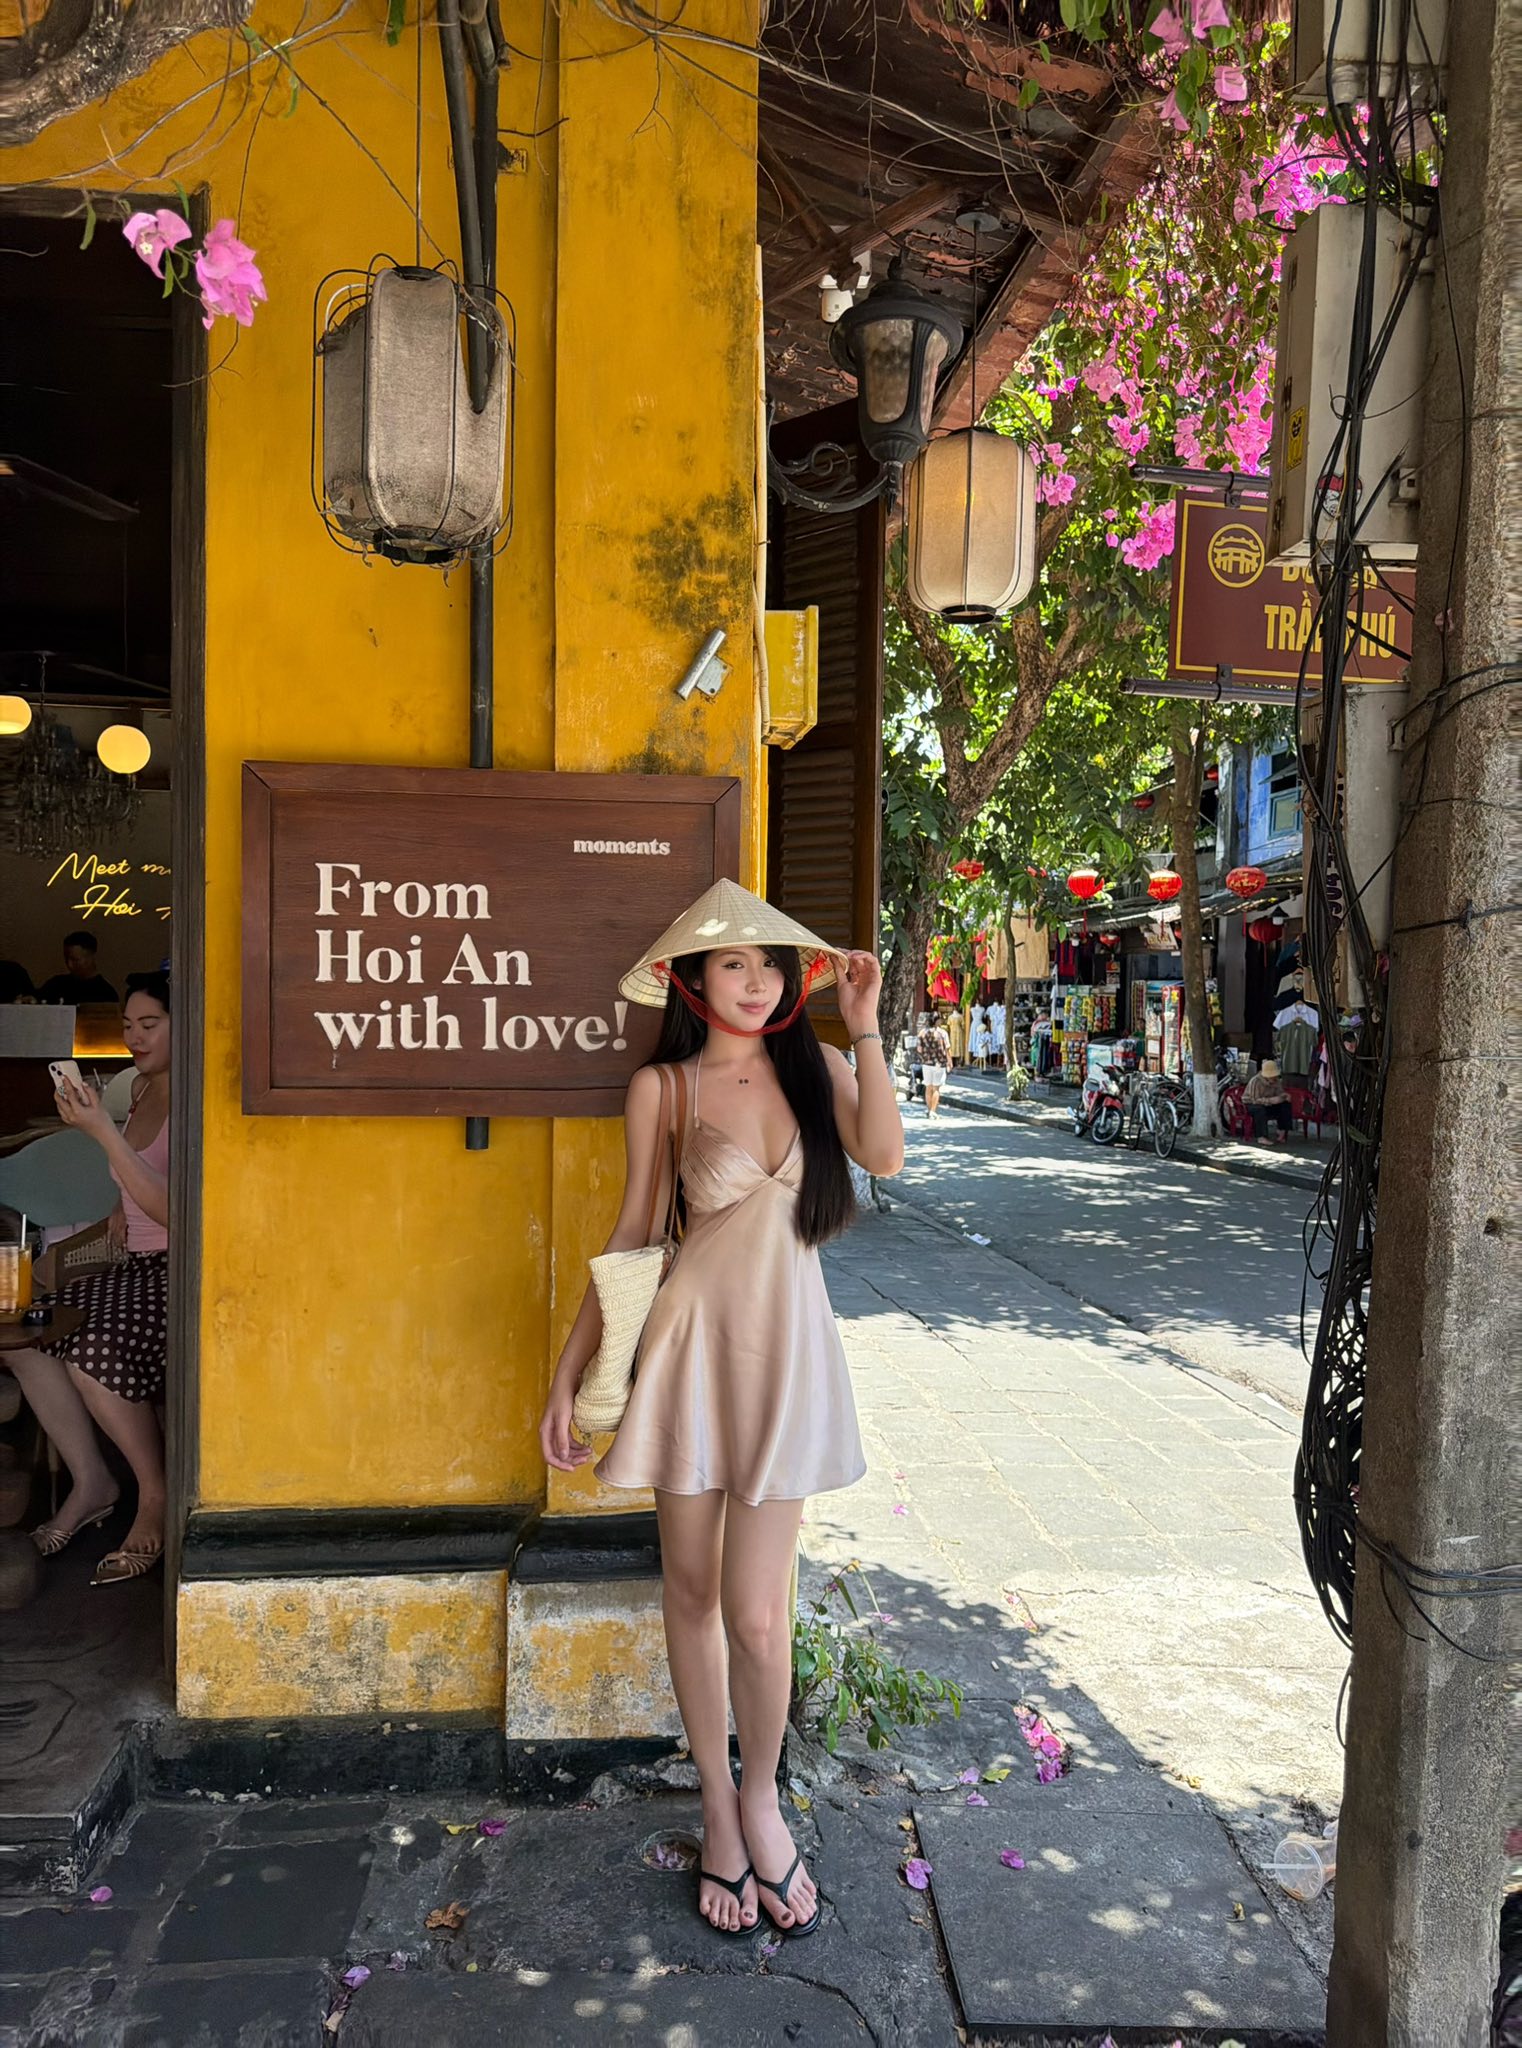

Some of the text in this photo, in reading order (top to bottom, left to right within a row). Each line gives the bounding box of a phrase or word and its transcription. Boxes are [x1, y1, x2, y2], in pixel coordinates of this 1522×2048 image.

[47, 852, 171, 887] Meet m
[573, 838, 671, 856] moments
[71, 884, 142, 920] Hoi
[314, 862, 492, 920] From
[314, 929, 533, 987] Hoi An
[314, 994, 628, 1052] with love!
